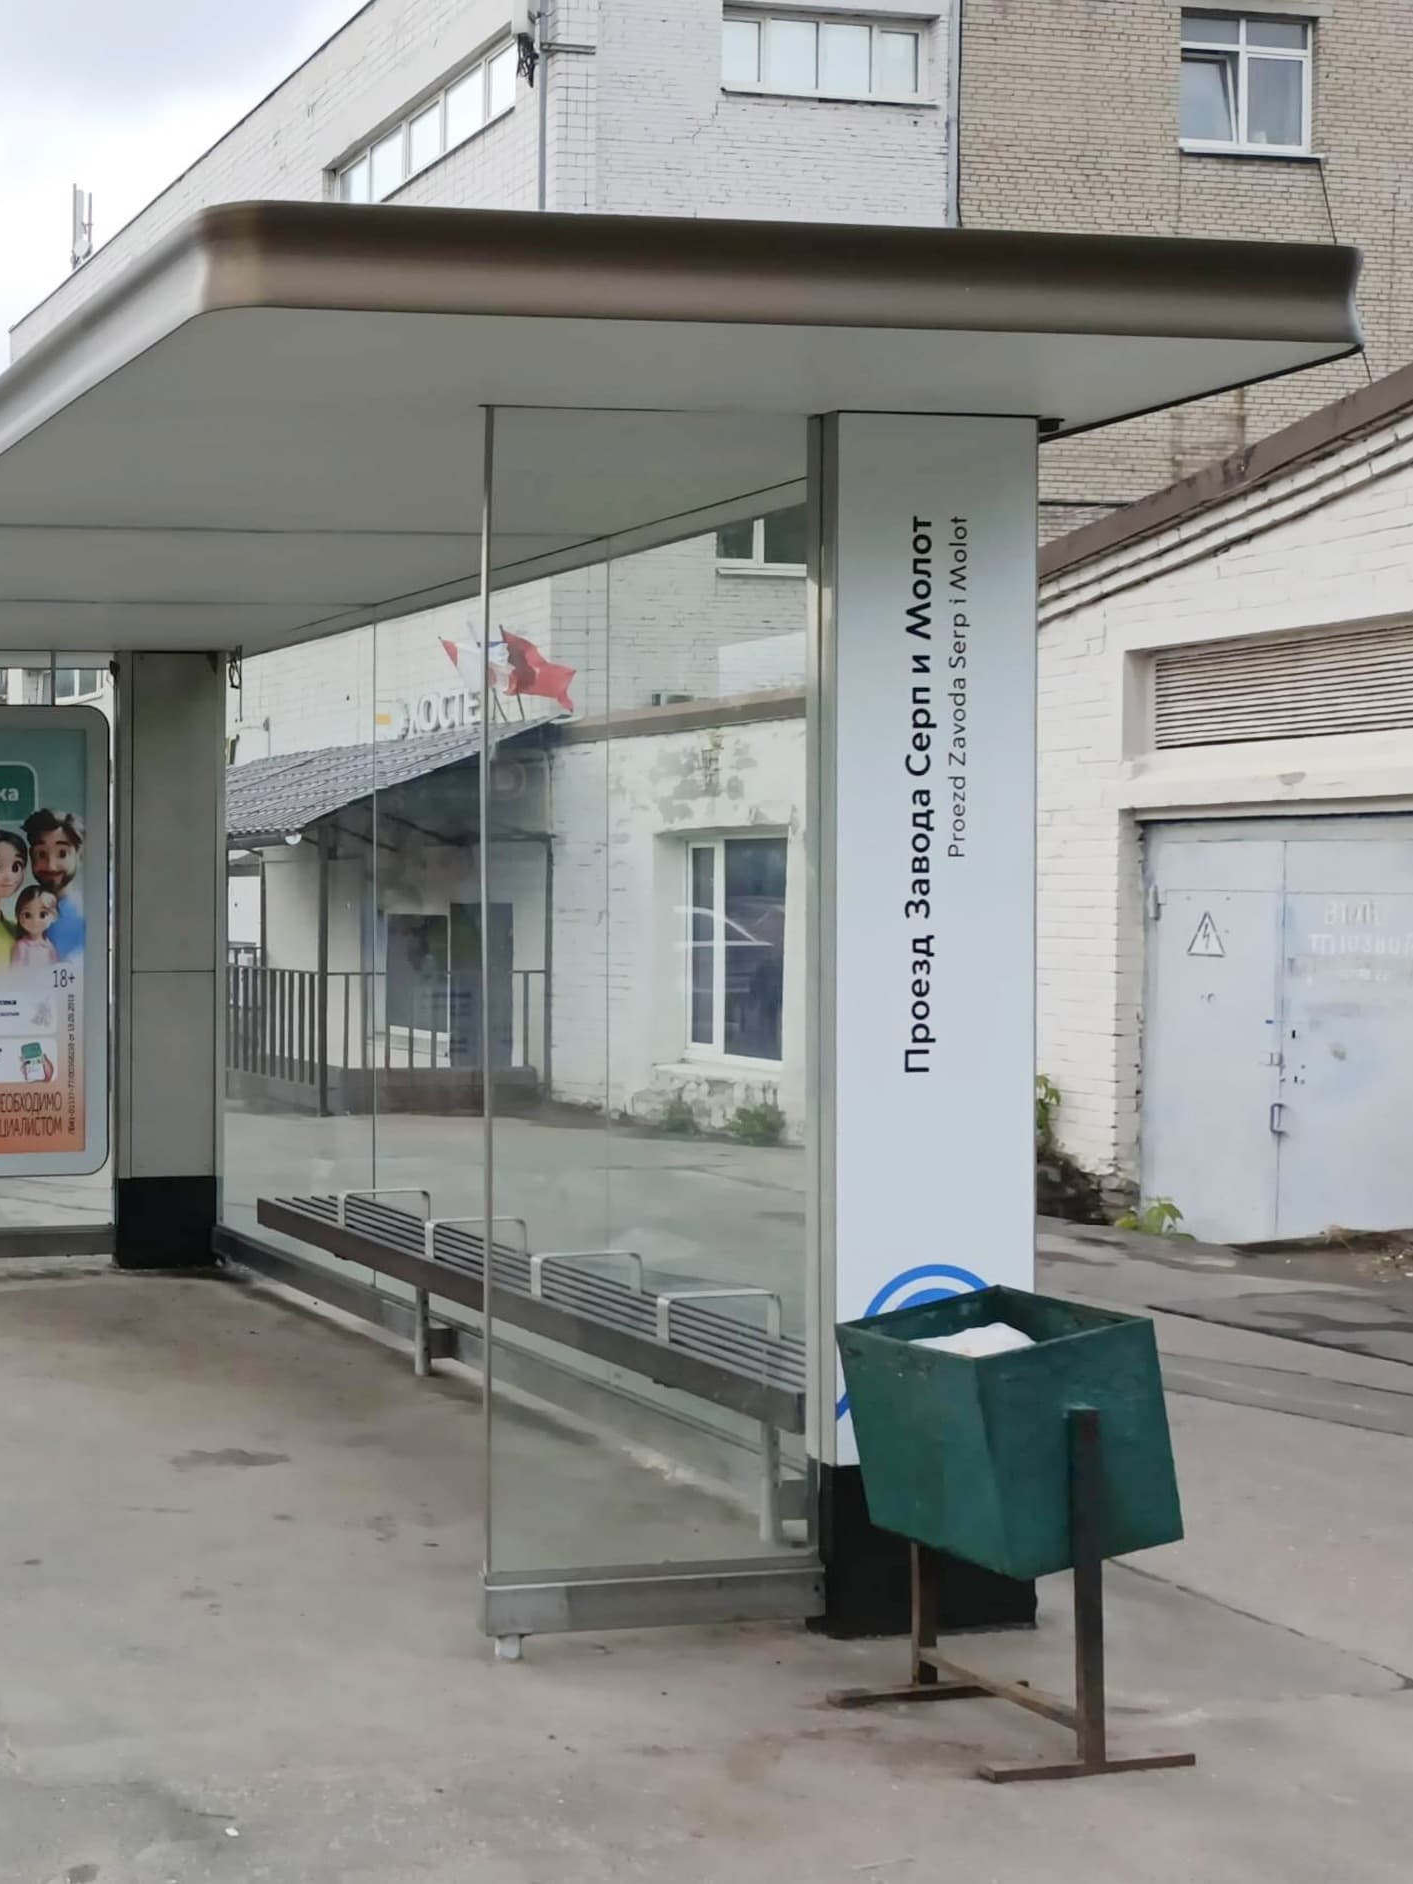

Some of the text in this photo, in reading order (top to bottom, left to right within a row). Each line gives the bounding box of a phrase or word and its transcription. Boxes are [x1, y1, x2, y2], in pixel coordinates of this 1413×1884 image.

[948, 516, 968, 591] Molot
[948, 612, 970, 669] Serp
[948, 677, 966, 767] Zavoda
[904, 515, 937, 1073] Проезд Завода Серп и Молот
[948, 775, 966, 858] Proezd
[52, 970, 76, 988] 18+
